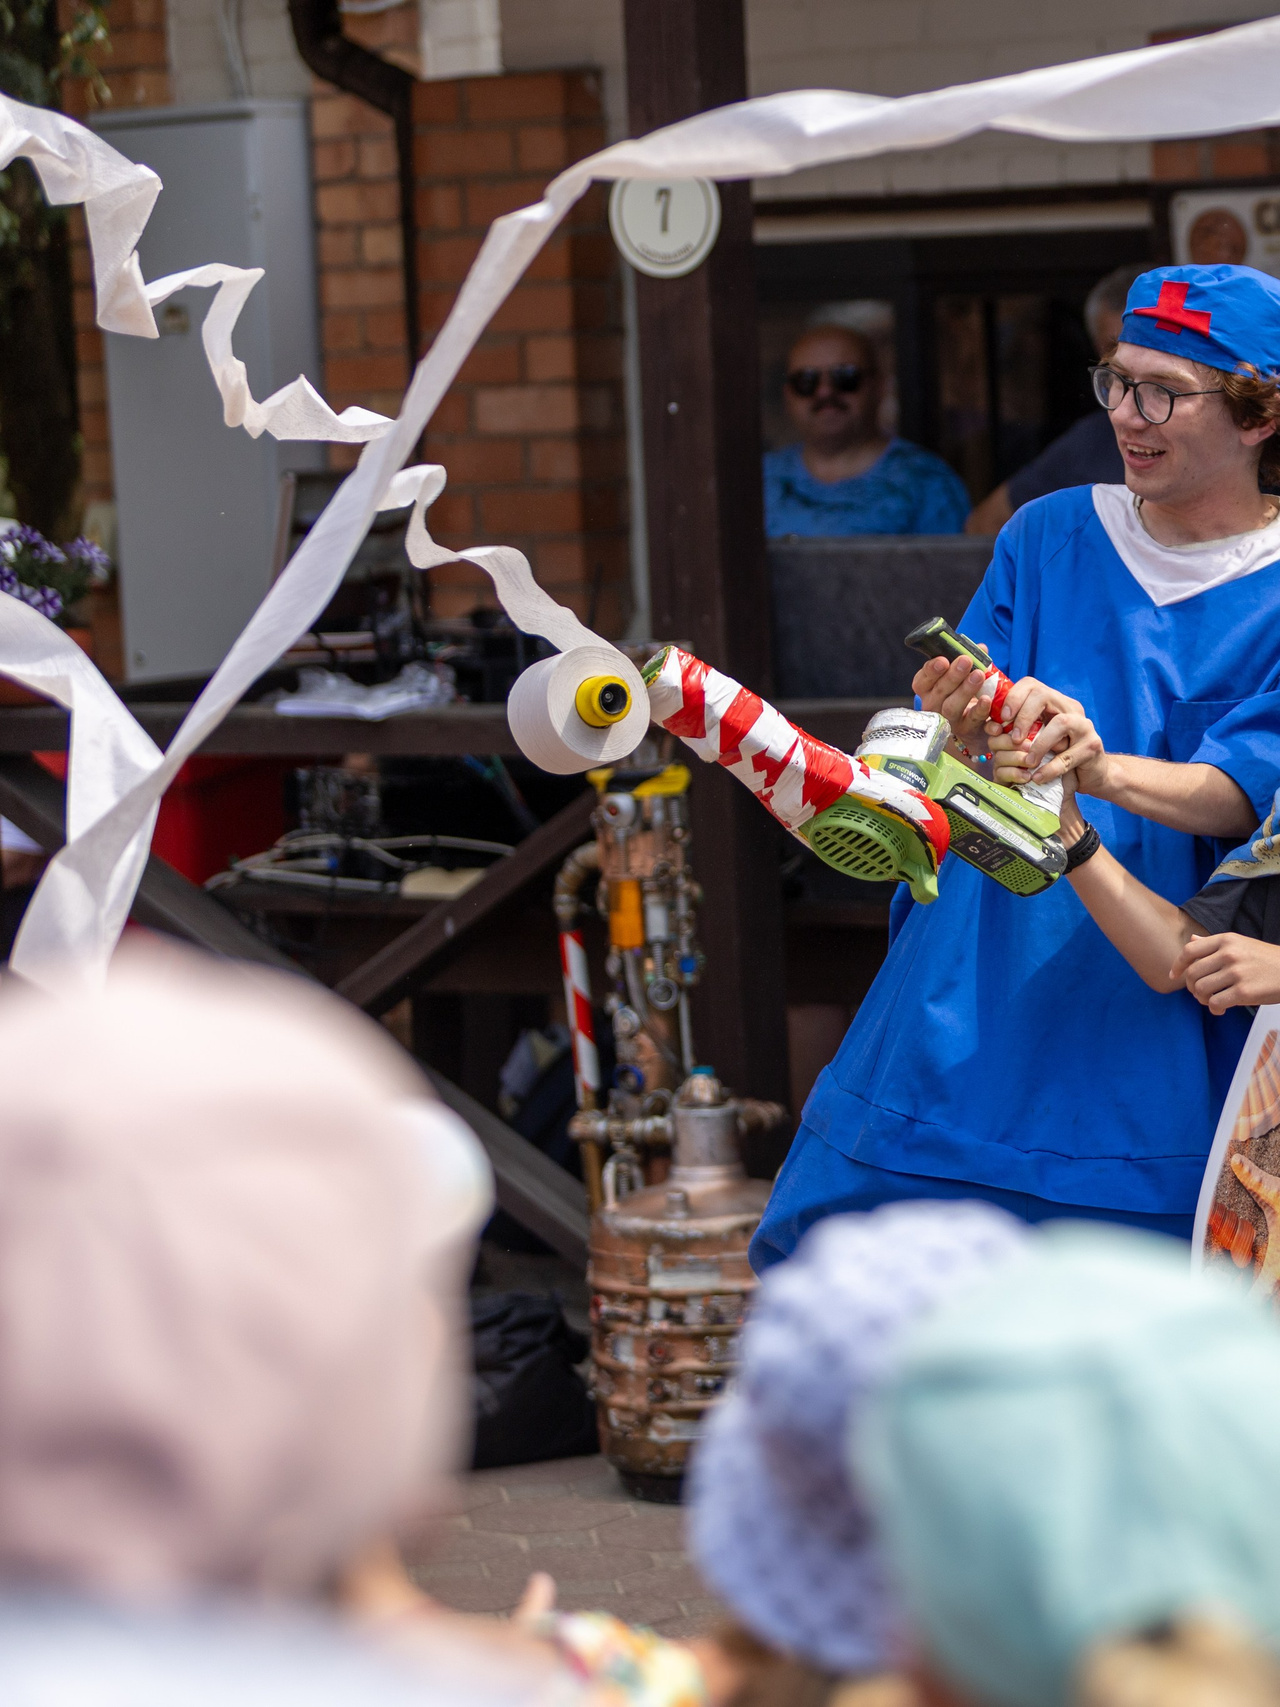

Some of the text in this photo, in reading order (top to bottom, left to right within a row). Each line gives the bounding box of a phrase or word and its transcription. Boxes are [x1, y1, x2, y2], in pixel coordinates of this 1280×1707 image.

[655, 186, 672, 233] 7
[888, 762, 927, 788] greenworks
[900, 772, 915, 784] TOOLS
